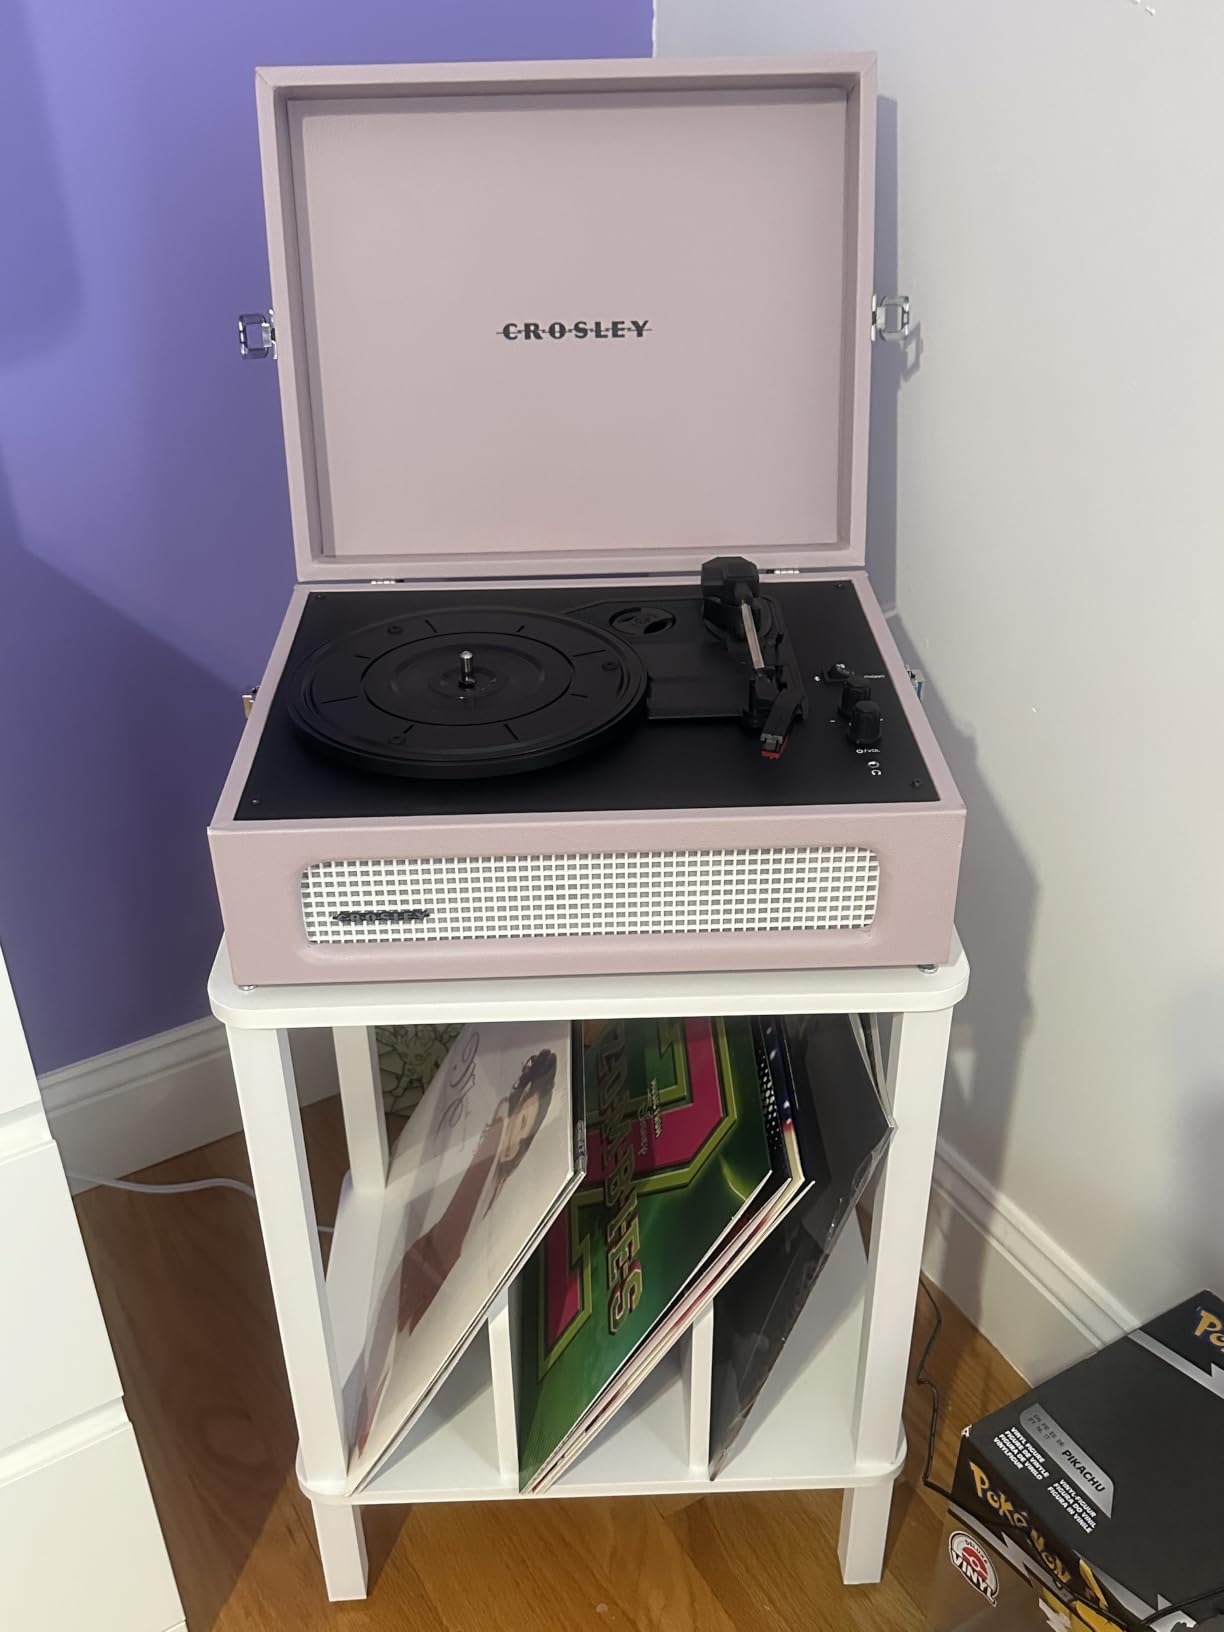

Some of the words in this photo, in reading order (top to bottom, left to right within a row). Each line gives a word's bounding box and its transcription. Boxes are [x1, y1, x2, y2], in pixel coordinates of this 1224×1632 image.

[499, 319, 651, 341] CROSLEY
[332, 908, 431, 925] CROSLEY
[993, 1437, 1024, 1470] VINYLFIGUR
[998, 1433, 1018, 1455] FIGURA
[1017, 1453, 1027, 1463] DE
[1024, 1461, 1043, 1480] VINILO
[1004, 1430, 1024, 1451] FIGURE
[1022, 1448, 1032, 1459] DE
[1030, 1457, 1050, 1478] VINYLE
[1011, 1427, 1027, 1444] VINYL
[1025, 1443, 1046, 1463] FIGURE
[1061, 1449, 1106, 1493] PIKACHU
[1047, 1486, 1068, 1508] FIGURA
[1066, 1506, 1075, 1515] IN
[1073, 1513, 1093, 1534] VINILE
[1053, 1482, 1074, 1505] FIGURA
[1072, 1503, 1083, 1513] DO
[1081, 1511, 1097, 1529] VINIL
[1059, 1479, 1097, 1518] VINYL-FIGUUR
[952, 1549, 996, 1604] VINYL
